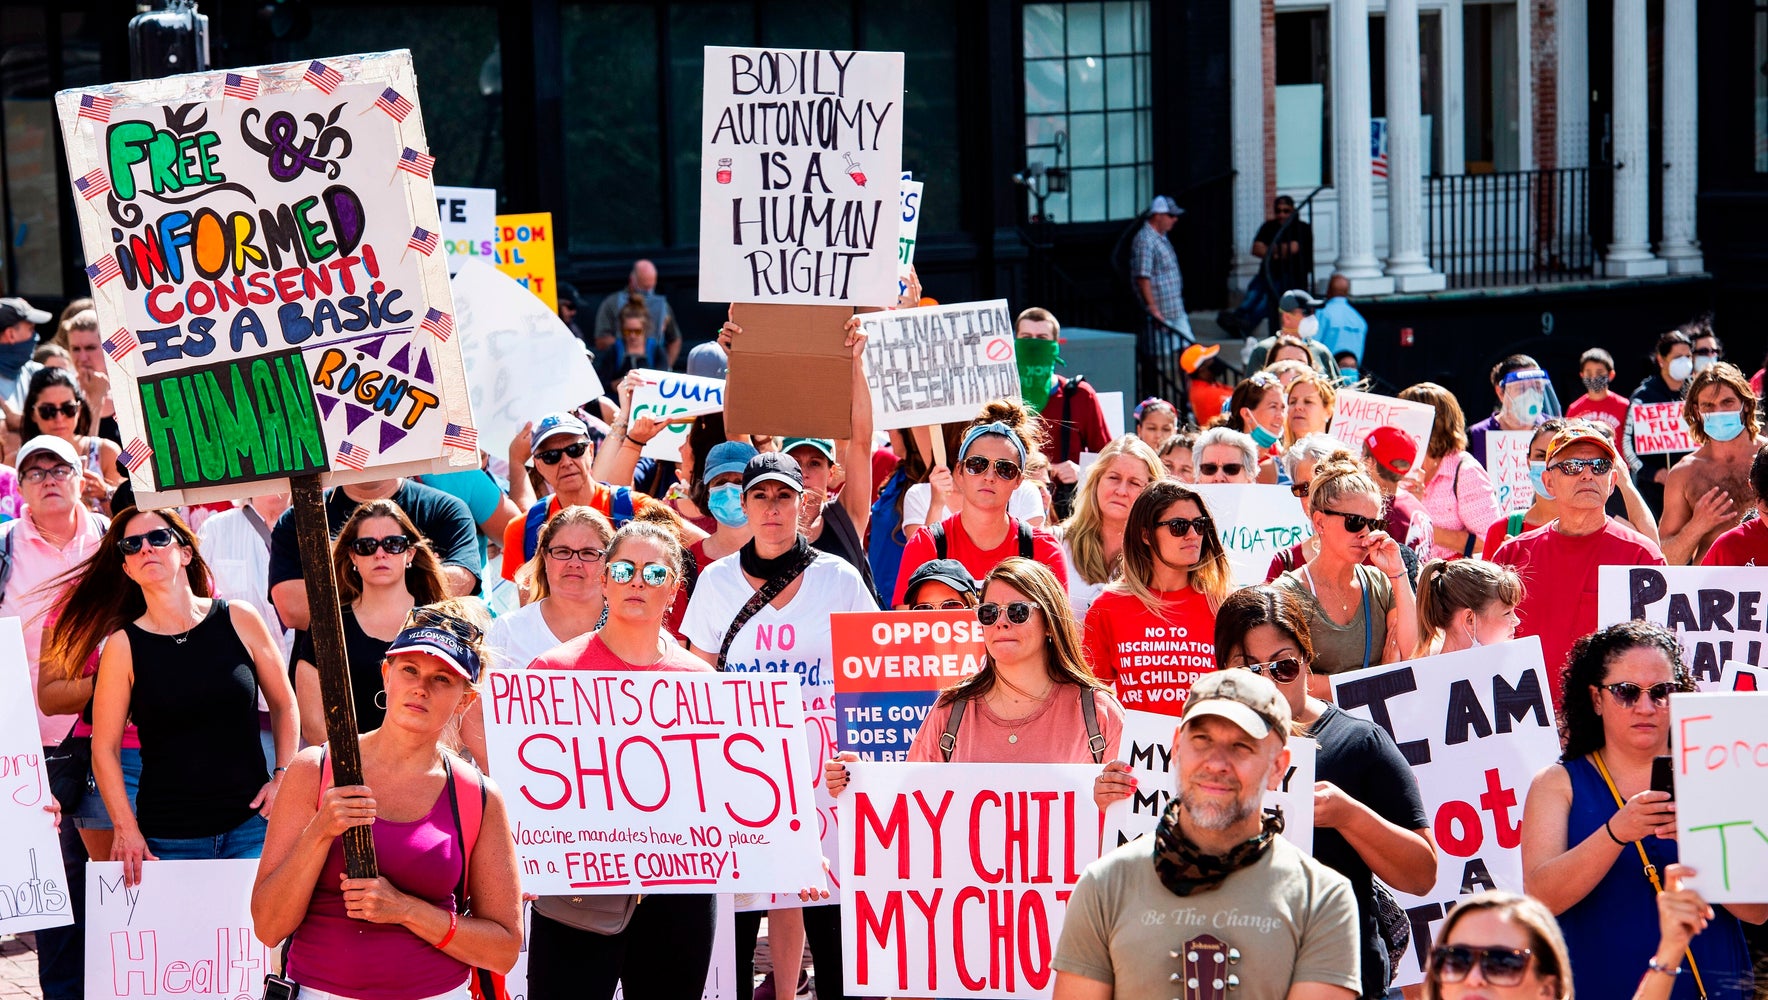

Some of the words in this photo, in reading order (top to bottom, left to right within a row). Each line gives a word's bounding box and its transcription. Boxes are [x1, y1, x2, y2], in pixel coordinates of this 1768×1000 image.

[729, 50, 857, 98] BODILY
[711, 97, 893, 150] AUTONOMY
[106, 120, 226, 200] FREE
[252, 106, 340, 182] &
[760, 152, 792, 190] IS
[802, 152, 833, 193] A
[732, 195, 882, 249] HUMAN
[145, 244, 386, 324] CONSENT!
[744, 248, 869, 299] RIGHT
[136, 317, 217, 366] IS
[230, 308, 267, 352] A
[1541, 311, 1554, 335] 9
[866, 332, 981, 376] WITHOUT
[140, 353, 325, 487] HUMAN
[1340, 396, 1408, 426] WHERE
[1649, 420, 1679, 433] FLU
[1635, 432, 1702, 454] MANDAT
[1629, 568, 1768, 633] PARE
[756, 624, 795, 651] NO
[872, 621, 984, 645] OPPOSE
[1145, 627, 1165, 638] NO
[1169, 627, 1188, 638] TO
[1120, 656, 1131, 668] IN
[1134, 655, 1215, 668] EDUCATION.
[490, 672, 643, 726] PARENTS
[649, 678, 724, 728] CALL
[723, 680, 793, 728] THE
[844, 707, 882, 722] THE
[888, 706, 932, 722] GOV
[1336, 667, 1432, 766] I
[1445, 668, 1550, 745] AM
[847, 729, 897, 744] DOES
[518, 733, 801, 832] SHOTS!
[578, 827, 647, 843] mandates
[650, 826, 687, 845] have
[690, 826, 722, 847] NO
[729, 830, 770, 848] place
[854, 790, 954, 879] MY
[522, 855, 540, 875] in
[547, 861, 560, 874] a
[565, 852, 629, 881] FREE
[634, 851, 741, 881] COUNTRY!
[1460, 858, 1497, 895] A
[99, 875, 140, 926] My
[1141, 909, 1166, 926] Be
[1171, 908, 1207, 926] The
[1212, 907, 1282, 934] Change
[110, 928, 273, 996] Healt
[855, 888, 943, 990] MY
